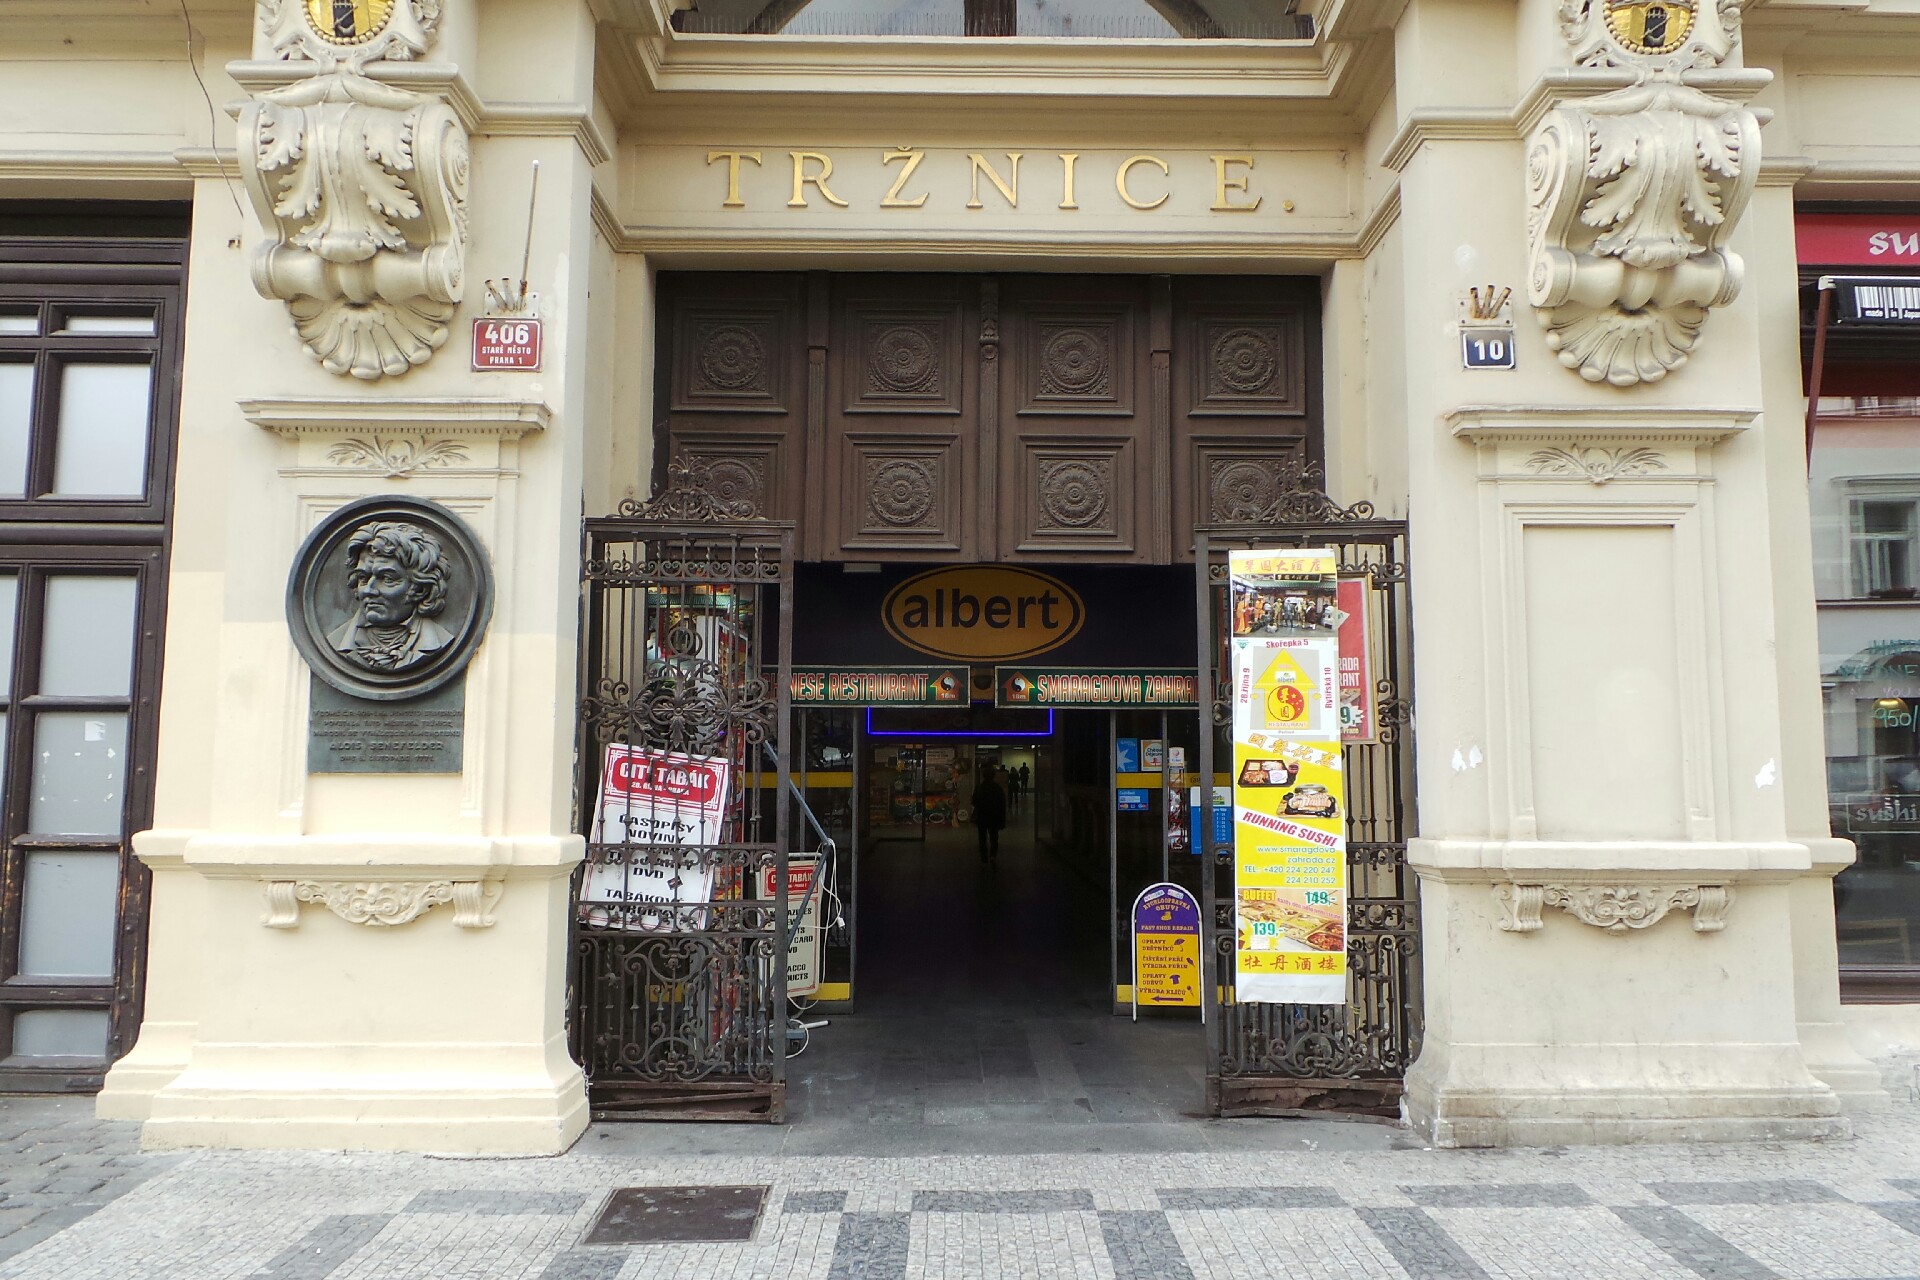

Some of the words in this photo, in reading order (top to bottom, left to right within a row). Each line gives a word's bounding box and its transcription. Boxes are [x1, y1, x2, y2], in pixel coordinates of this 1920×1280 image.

[1865, 309, 1883, 317] made
[1890, 309, 1898, 317] in
[485, 323, 529, 344] 406
[482, 344, 504, 354] STARÉ
[507, 344, 531, 355] MĚSTO
[1474, 339, 1504, 361] 10
[490, 356, 514, 365] PRAHA
[518, 356, 523, 365] 1
[902, 587, 1059, 630] albert
[1303, 638, 1309, 647] 5
[1324, 667, 1332, 676] 10
[762, 673, 825, 700] CHNESE
[828, 673, 930, 701] RESTAURANT
[1037, 674, 1142, 702] SMARAGDOVA
[1243, 811, 1298, 835] RUNNING
[1298, 828, 1338, 847] SUSHI
[633, 867, 664, 879] DVD
[1286, 876, 1301, 884] 224
[1303, 876, 1319, 884] 210
[1321, 876, 1336, 884] 252
[1243, 889, 1277, 901] BUFFET
